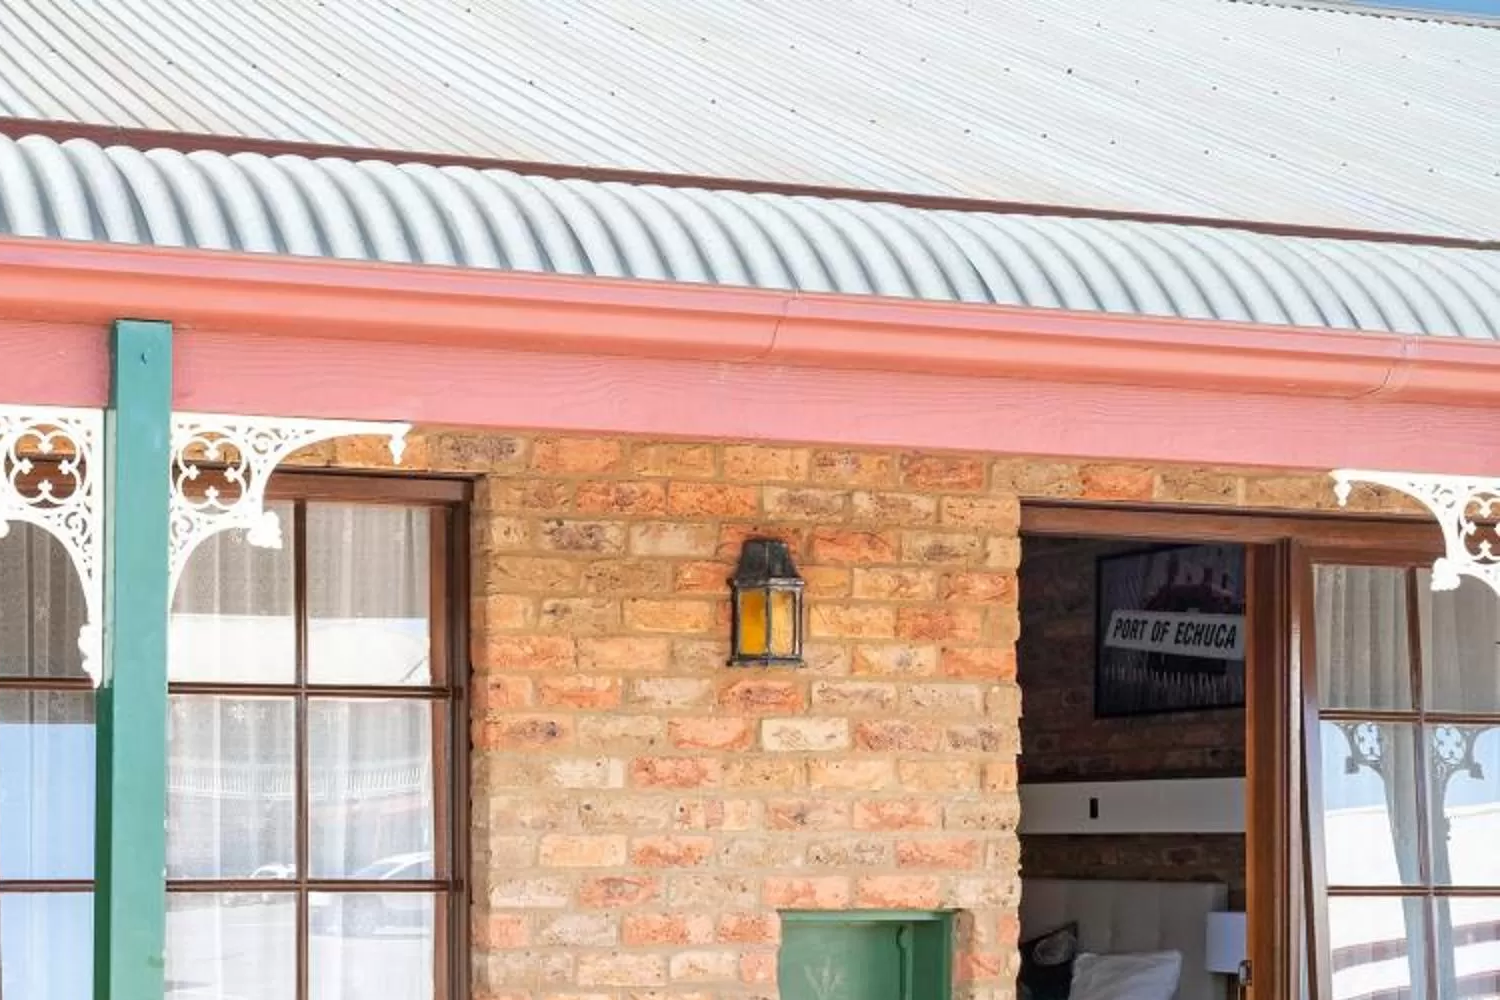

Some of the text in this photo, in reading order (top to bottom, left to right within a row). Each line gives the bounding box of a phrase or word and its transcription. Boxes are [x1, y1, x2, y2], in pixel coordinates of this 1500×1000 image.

[1112, 618, 1238, 649] PORT OF ECHUCA
